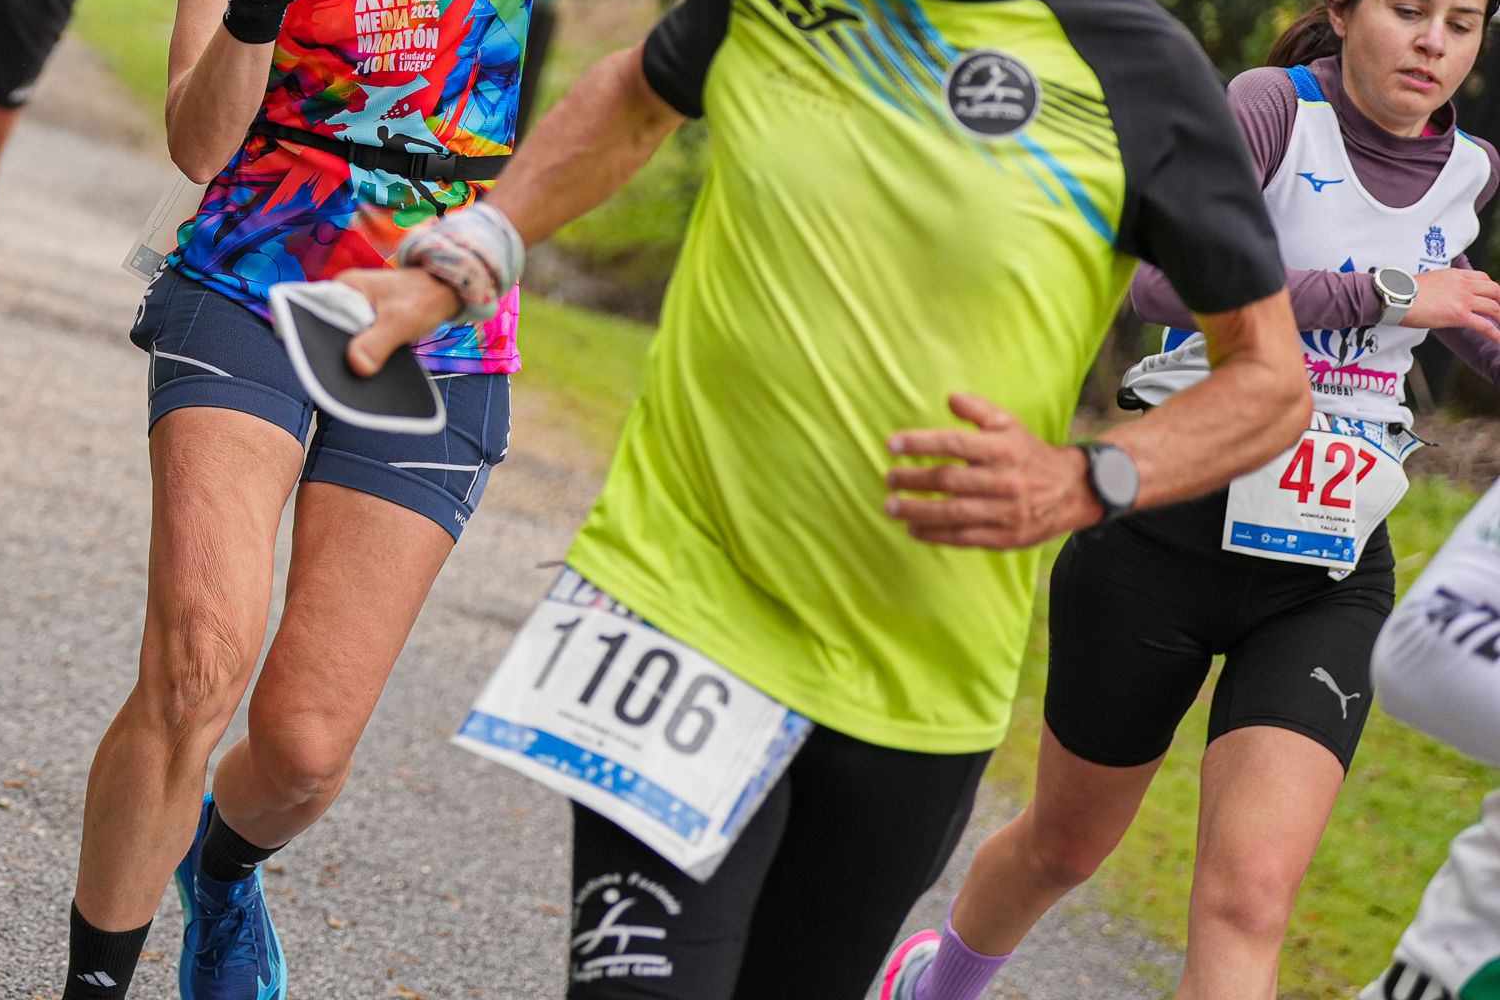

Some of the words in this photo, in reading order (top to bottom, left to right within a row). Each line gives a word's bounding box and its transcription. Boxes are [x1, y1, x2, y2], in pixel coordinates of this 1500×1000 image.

[355, 8, 410, 34] MEDIA
[410, 5, 440, 20] 2026
[357, 23, 439, 54] MARATÓN
[363, 53, 397, 75] 10K
[398, 60, 433, 73] LUCENA
[399, 51, 426, 61] Ciudad
[425, 51, 436, 61] de
[1279, 438, 1378, 510] 427
[533, 615, 731, 756] 1106
